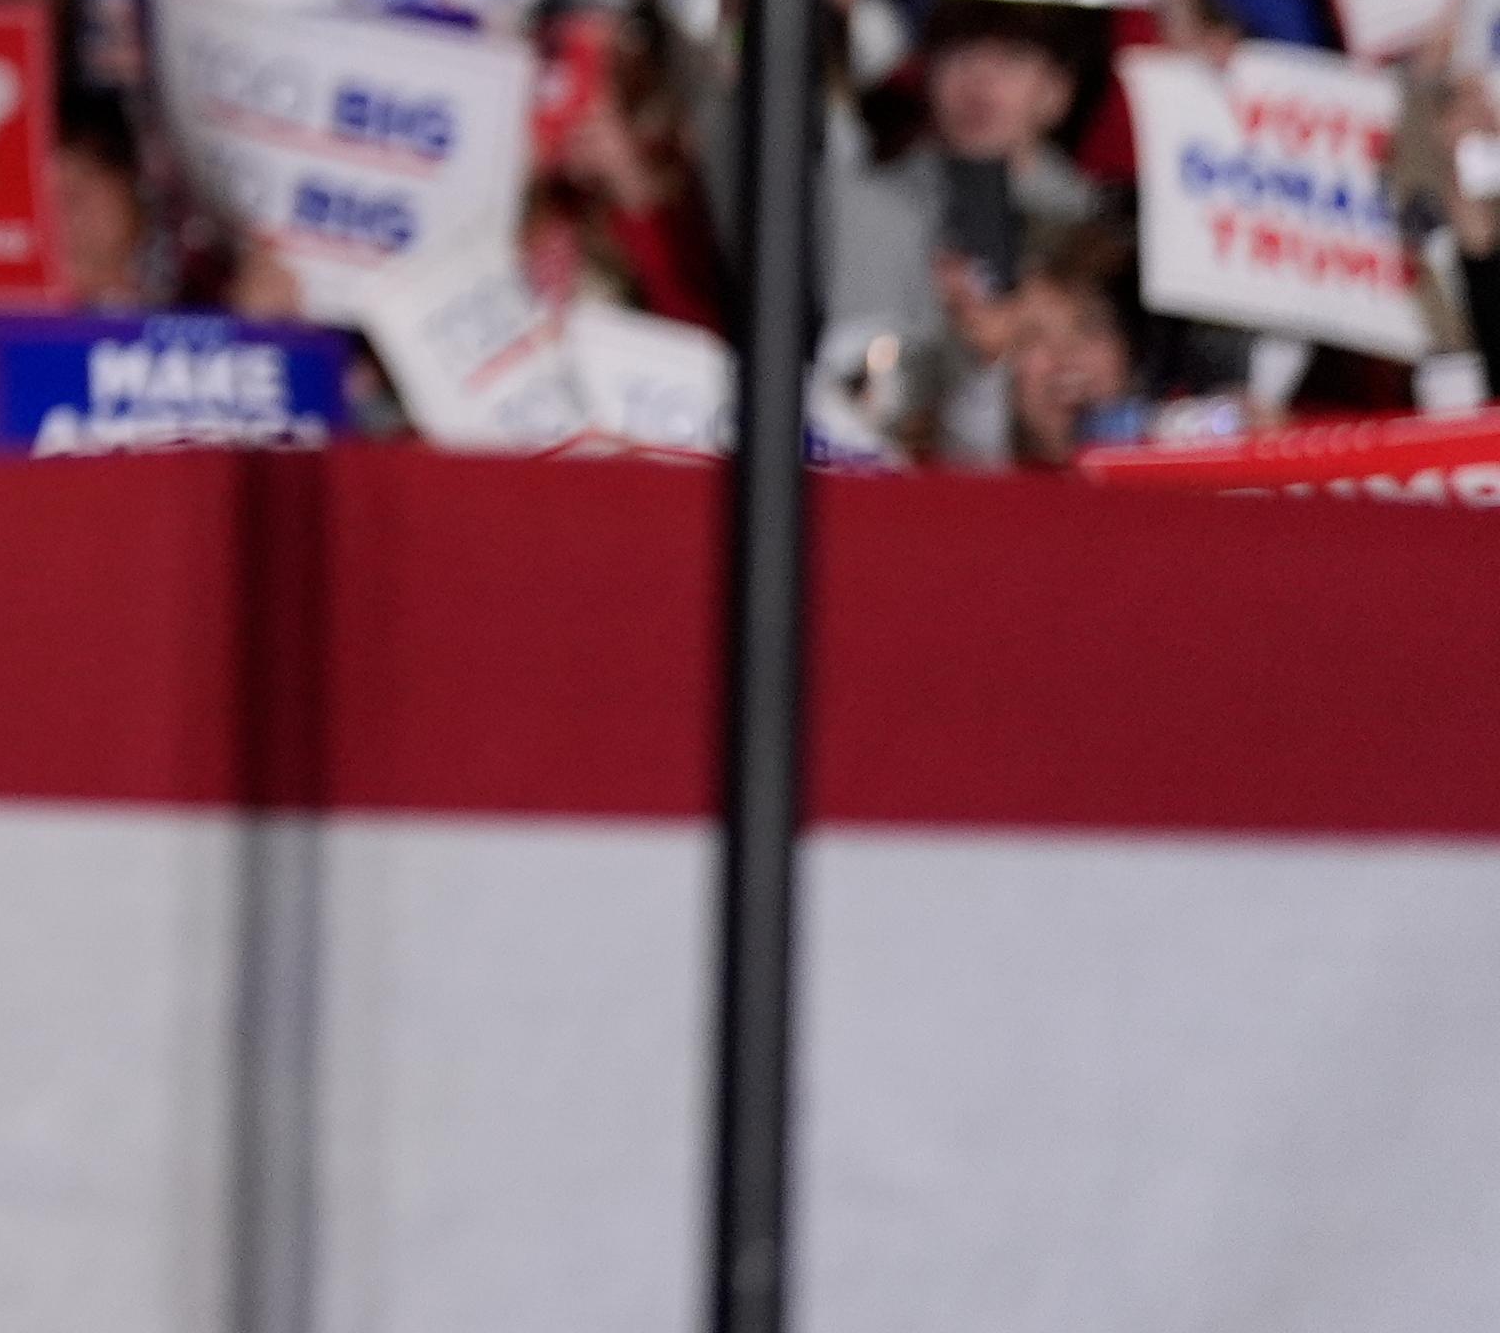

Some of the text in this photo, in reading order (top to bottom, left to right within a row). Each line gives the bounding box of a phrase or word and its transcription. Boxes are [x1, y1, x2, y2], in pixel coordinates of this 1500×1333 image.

[332, 81, 458, 161] BIG
[293, 175, 422, 255] RIG
[1180, 143, 1394, 229] DONAL
[1206, 209, 1422, 295] TRUMP
[87, 341, 288, 407] MAKE
